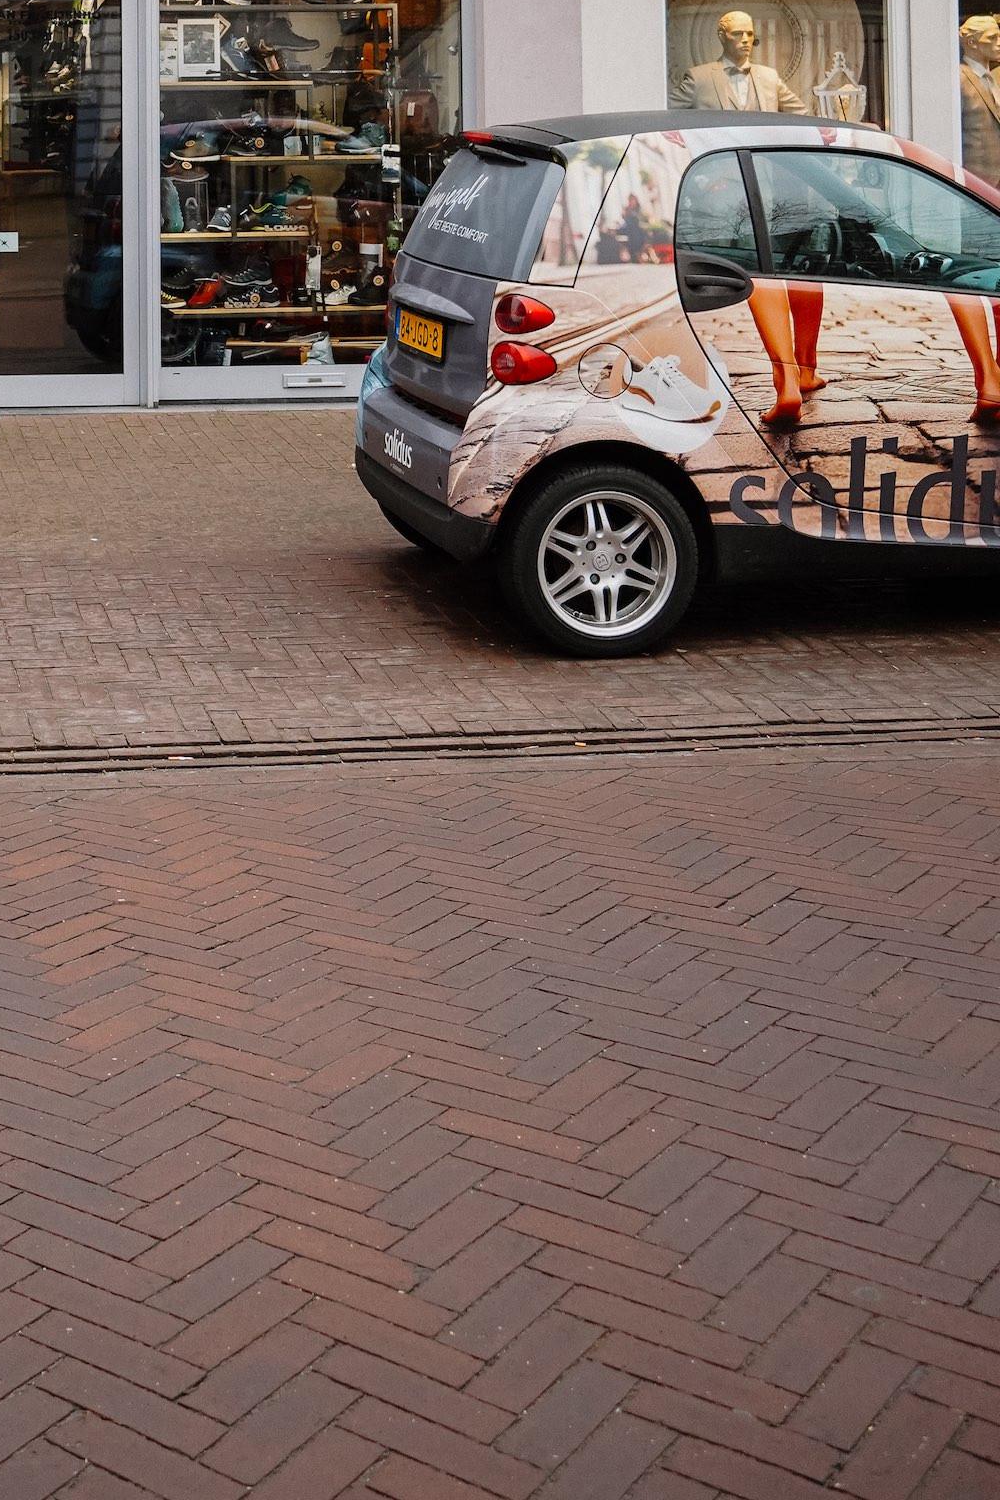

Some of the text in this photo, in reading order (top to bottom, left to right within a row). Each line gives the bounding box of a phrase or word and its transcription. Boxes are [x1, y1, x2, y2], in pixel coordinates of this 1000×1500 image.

[457, 225, 489, 244] COMFORT
[400, 315, 440, 352] 84-JGD-8
[383, 427, 413, 468] solidus
